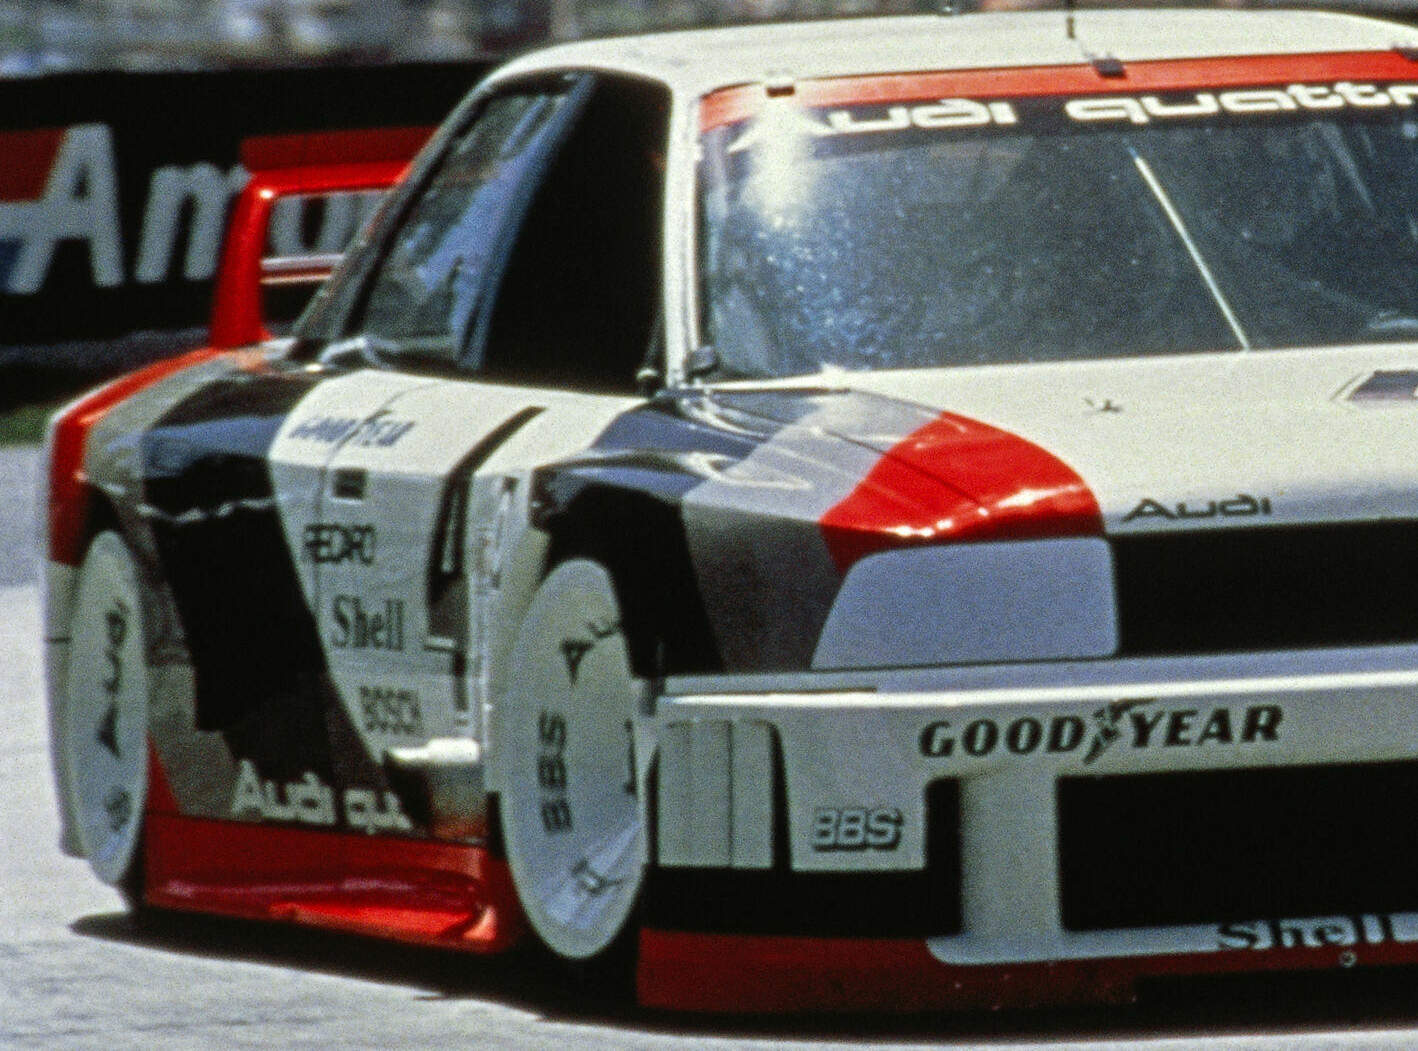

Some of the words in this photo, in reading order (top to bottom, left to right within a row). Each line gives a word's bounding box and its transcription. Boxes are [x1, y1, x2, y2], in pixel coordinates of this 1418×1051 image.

[1121, 494, 1272, 524] Audi
[333, 595, 404, 651] Shell
[230, 759, 338, 826] Audi
[537, 709, 574, 834] BBS
[813, 807, 905, 852] BBS
[1217, 913, 1395, 950] Shell
